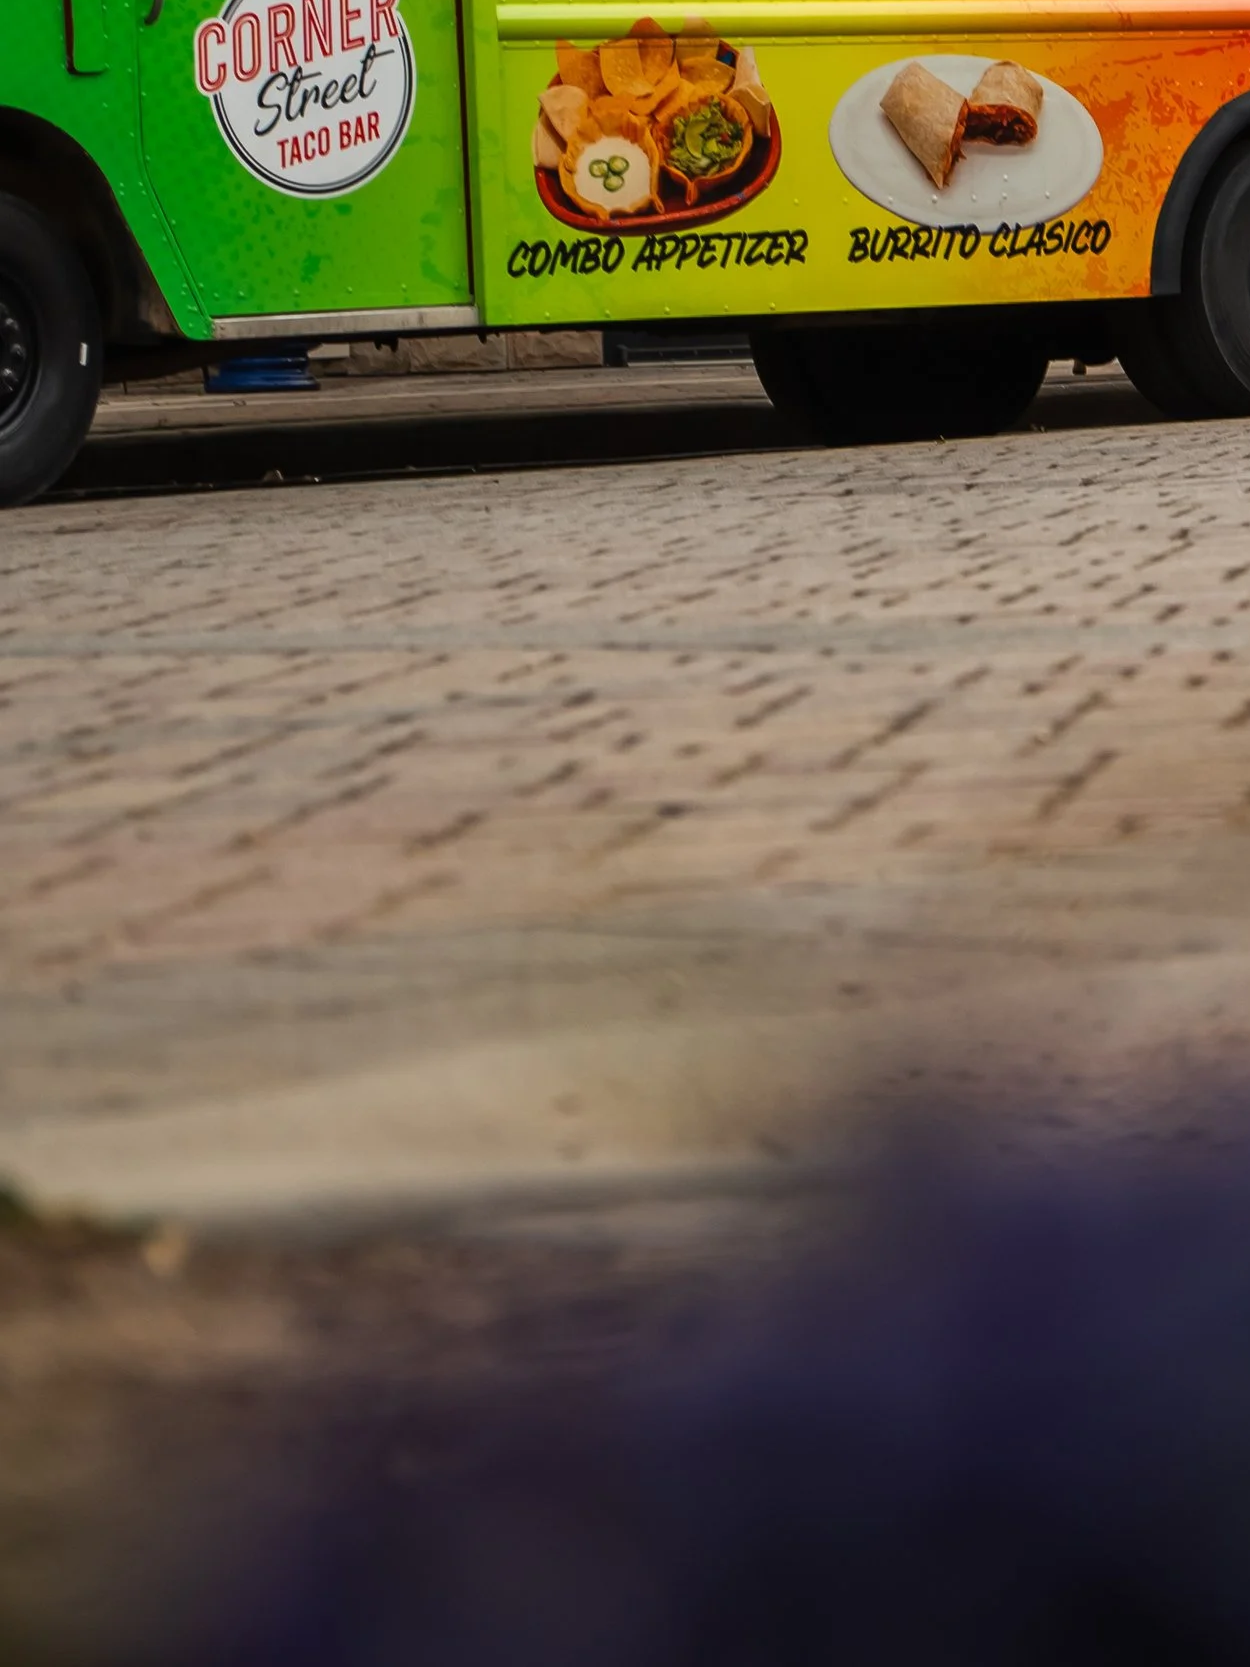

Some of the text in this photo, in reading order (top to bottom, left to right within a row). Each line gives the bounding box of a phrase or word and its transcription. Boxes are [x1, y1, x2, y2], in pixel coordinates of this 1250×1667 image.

[254, 44, 395, 136] Street
[276, 111, 380, 169] TACO BAR
[507, 229, 809, 278] COMBO APPETIZER
[848, 220, 1111, 265] BURRITO CLASICO
